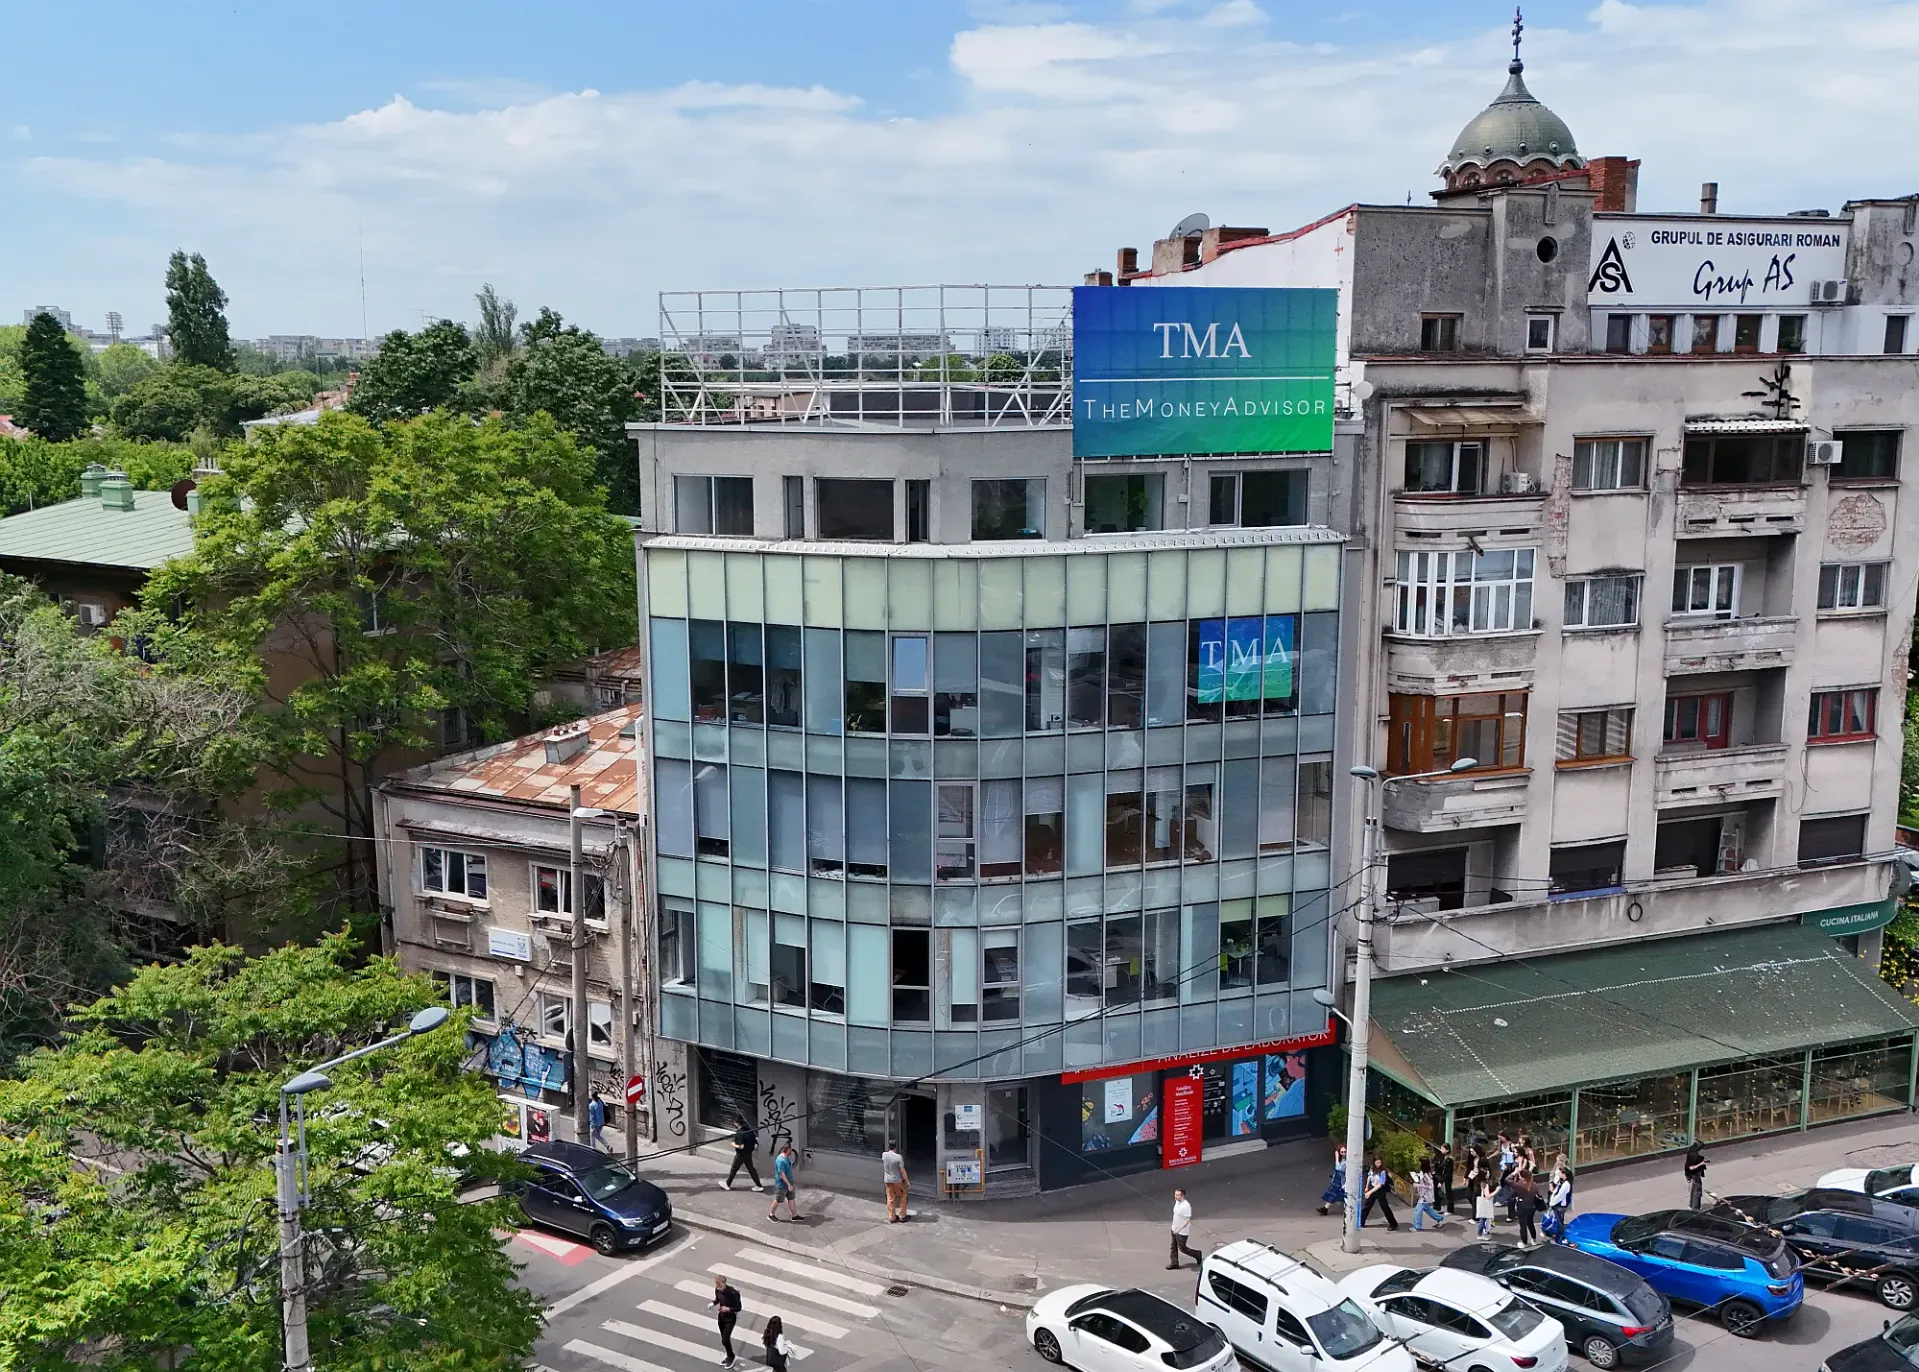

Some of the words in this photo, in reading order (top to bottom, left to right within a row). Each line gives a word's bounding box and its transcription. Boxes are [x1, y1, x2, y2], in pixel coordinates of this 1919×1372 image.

[1651, 230, 1703, 245] GRUPUL
[1707, 231, 1723, 245] DE
[1726, 233, 1792, 247] ASIGURARI
[1796, 234, 1840, 247] ROMAN
[1693, 260, 1754, 304] Grup
[1763, 253, 1796, 294] AS
[1153, 322, 1252, 358] TMA
[1201, 638, 1291, 668] TMA
[1820, 916, 1850, 927] CUCINA
[1850, 911, 1879, 924] ITALIANA
